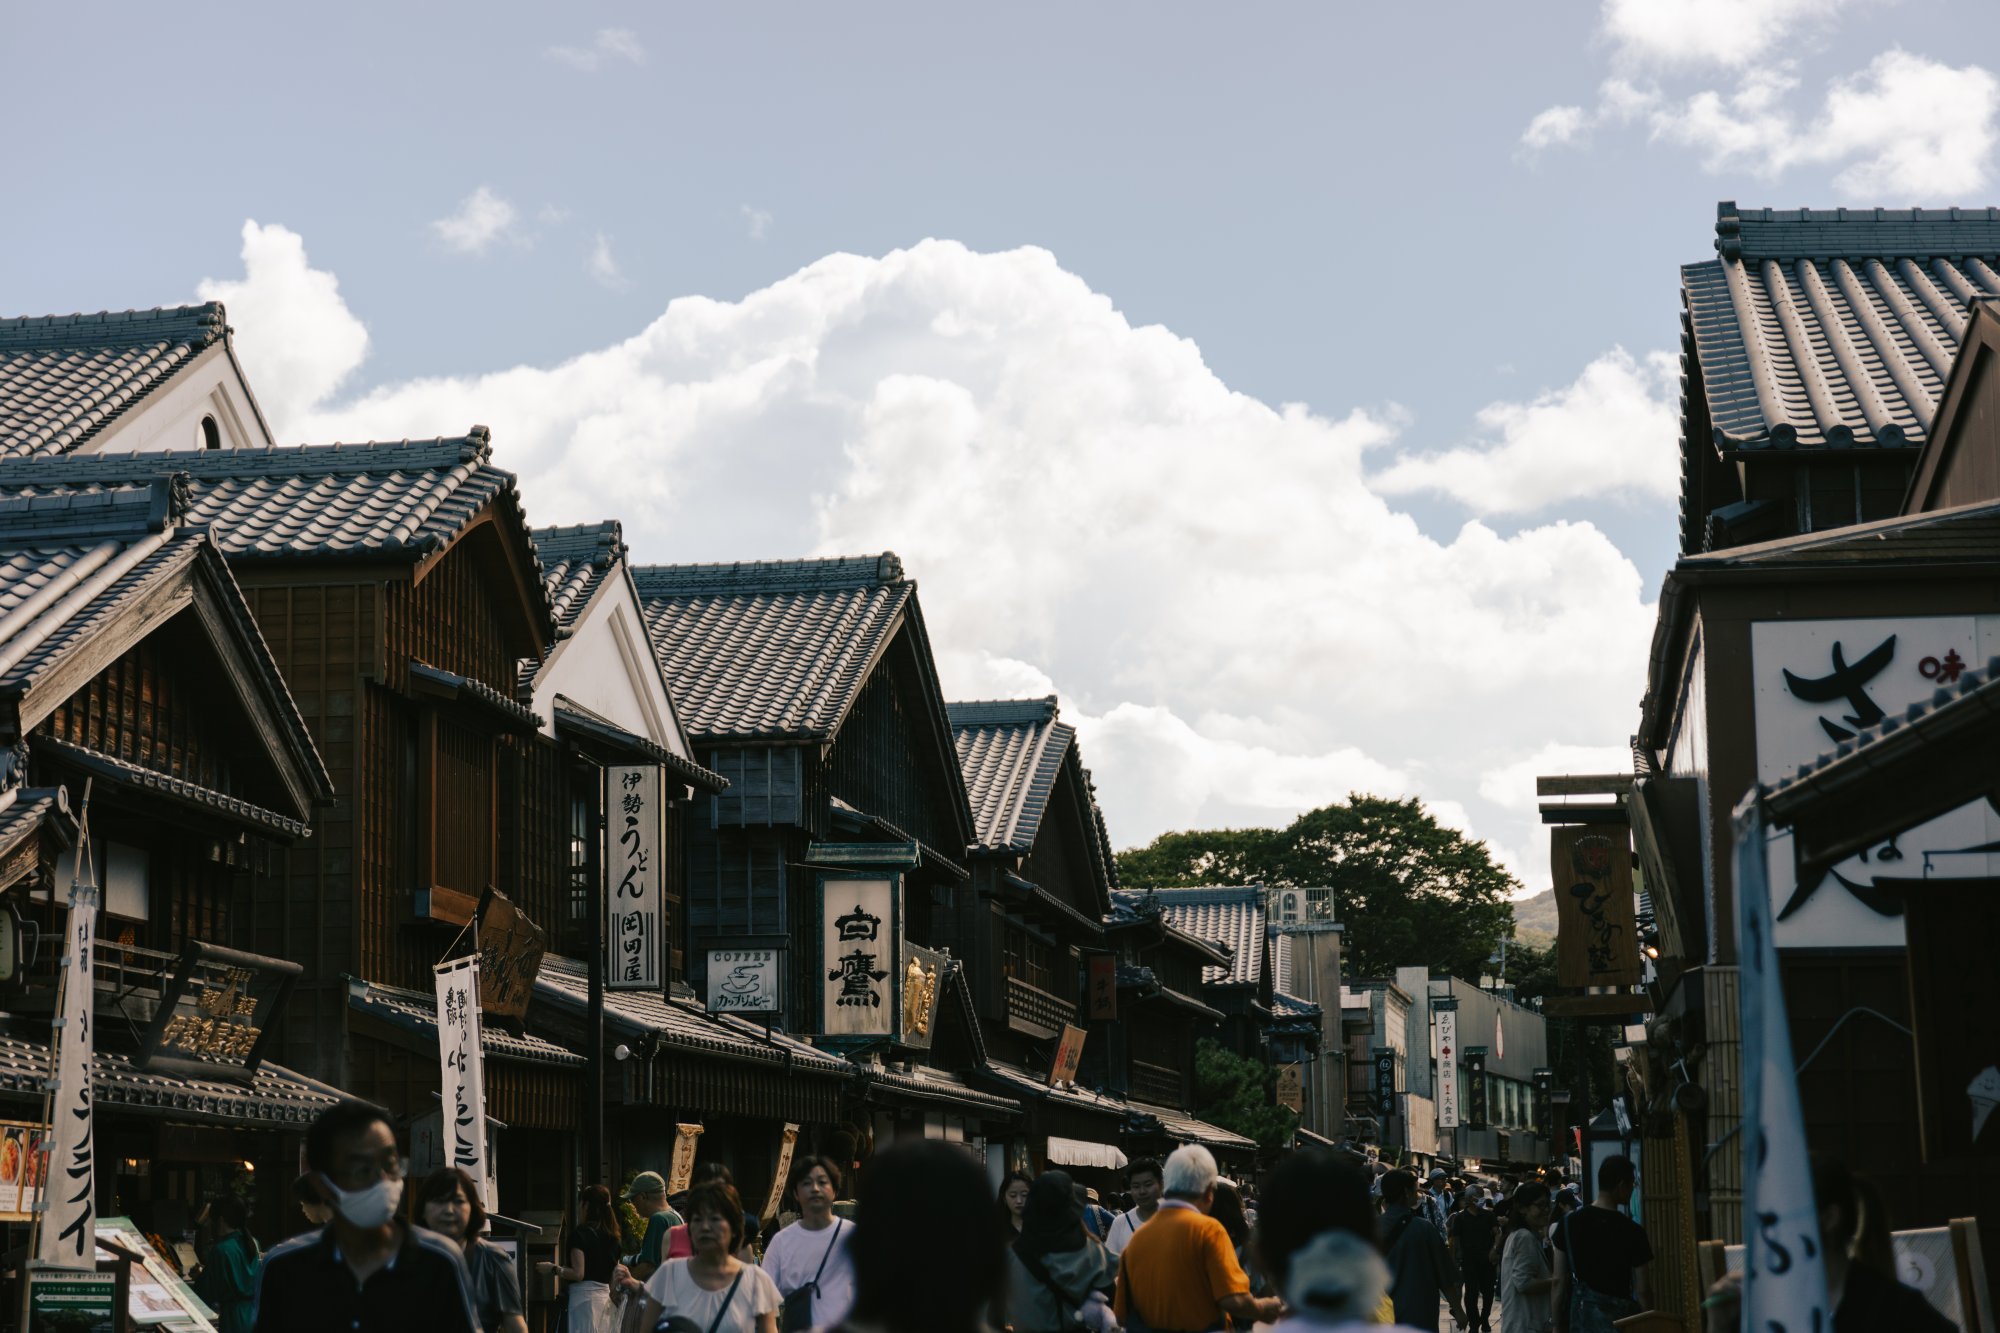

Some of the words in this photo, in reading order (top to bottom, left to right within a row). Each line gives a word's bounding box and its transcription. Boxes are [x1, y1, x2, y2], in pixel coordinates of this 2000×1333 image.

[618, 773, 648, 899] 伊勢うどん
[622, 911, 643, 982] 岡田屋
[715, 952, 771, 962] COFFEE
[829, 904, 890, 1008] 白鷹
[1442, 1061, 1451, 1079] 商店
[1443, 1096, 1453, 1125] 大食堂
